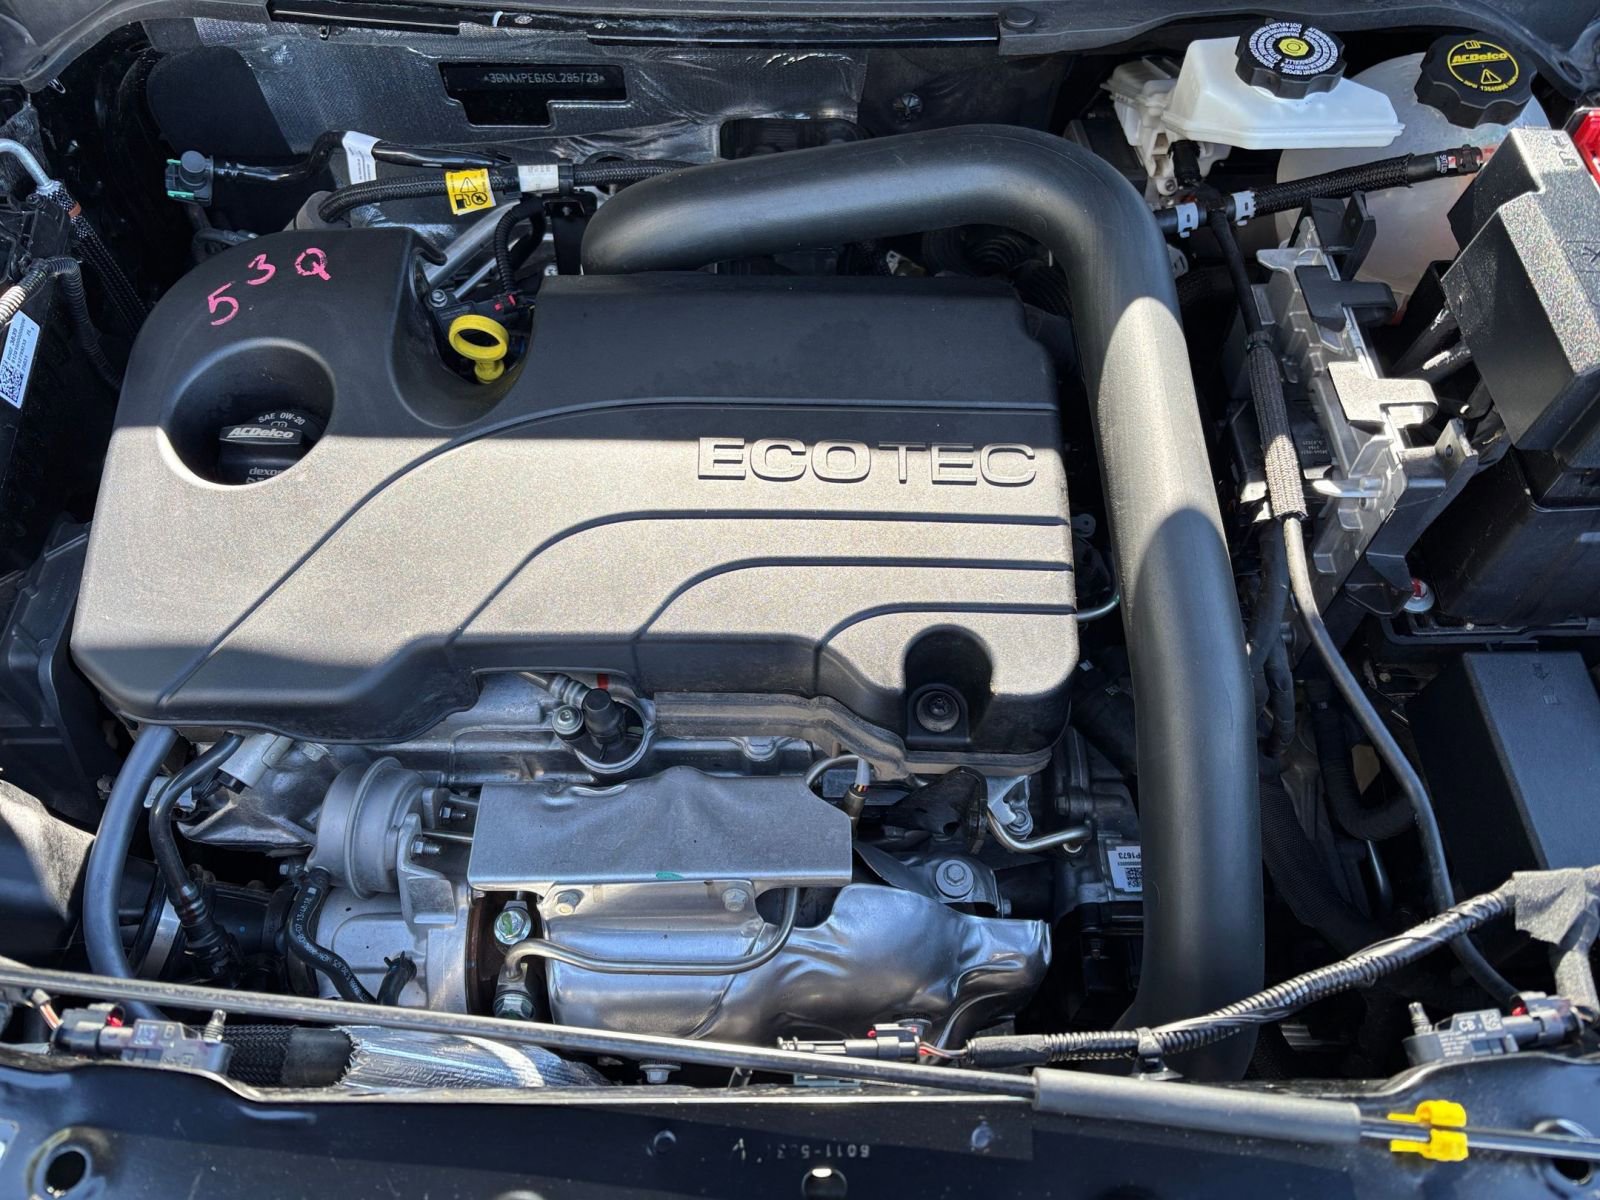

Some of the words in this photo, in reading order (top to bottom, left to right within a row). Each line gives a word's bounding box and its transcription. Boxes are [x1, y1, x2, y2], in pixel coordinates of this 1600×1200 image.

[1452, 52, 1508, 63] ACDelco
[258, 412, 276, 423] SAE
[280, 412, 306, 426] 0W-20
[227, 427, 295, 439] ACDelco
[697, 437, 1036, 488] ECOTEC
